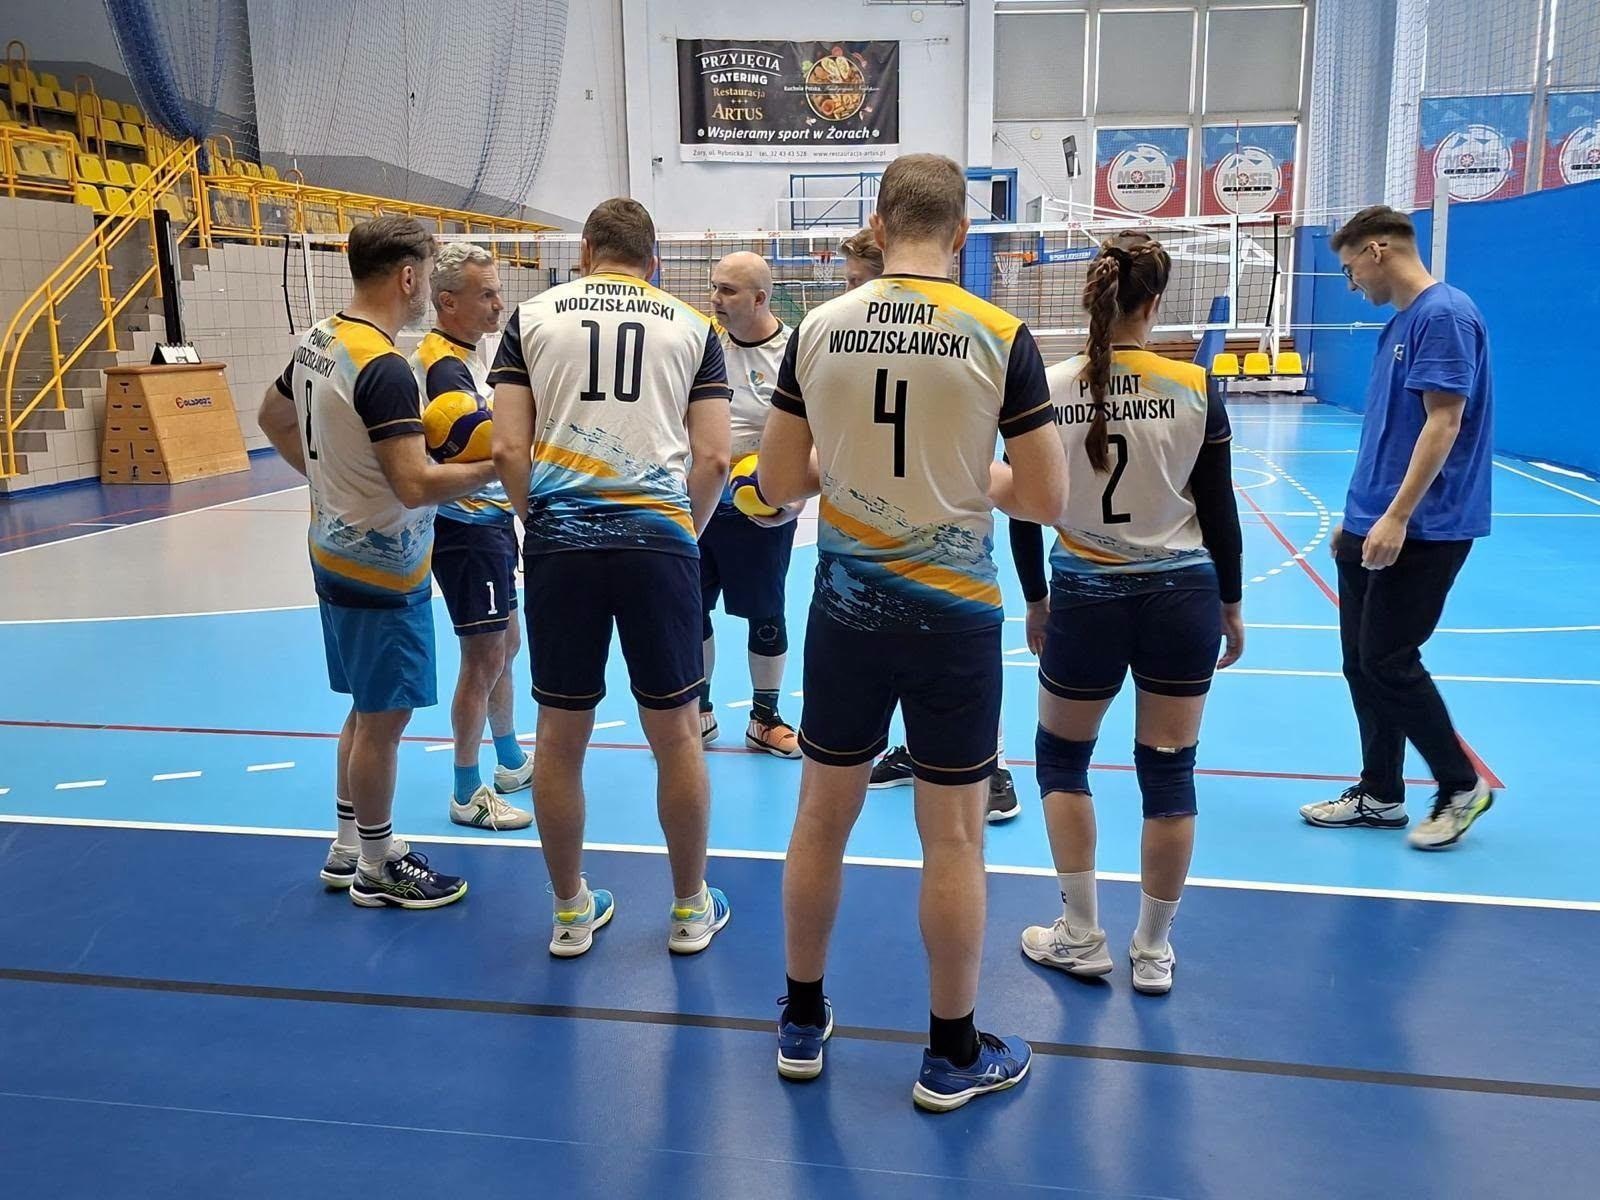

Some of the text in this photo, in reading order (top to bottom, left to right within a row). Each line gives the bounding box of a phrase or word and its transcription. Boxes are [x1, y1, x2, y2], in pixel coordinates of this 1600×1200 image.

[700, 53, 780, 71] PRZYJĘCIA
[710, 72, 768, 85] CATERING
[713, 87, 766, 100] Restauracja
[712, 103, 763, 121] ARTUS
[707, 125, 870, 142] Wspieramy sport w Żorach
[585, 283, 646, 297] POWIAT
[555, 297, 675, 321] WODZISŁAWSKI
[866, 302, 938, 325] POWIAT
[308, 328, 336, 351] POWIAT
[829, 330, 970, 360] WODZISŁAWSKI
[580, 320, 645, 402] 10
[1080, 374, 1141, 398] PWIAT
[874, 368, 908, 478] 4
[1055, 398, 1175, 426] WODZSŁAWSKI
[1102, 433, 1131, 524] 2
[486, 581, 498, 615] 1
